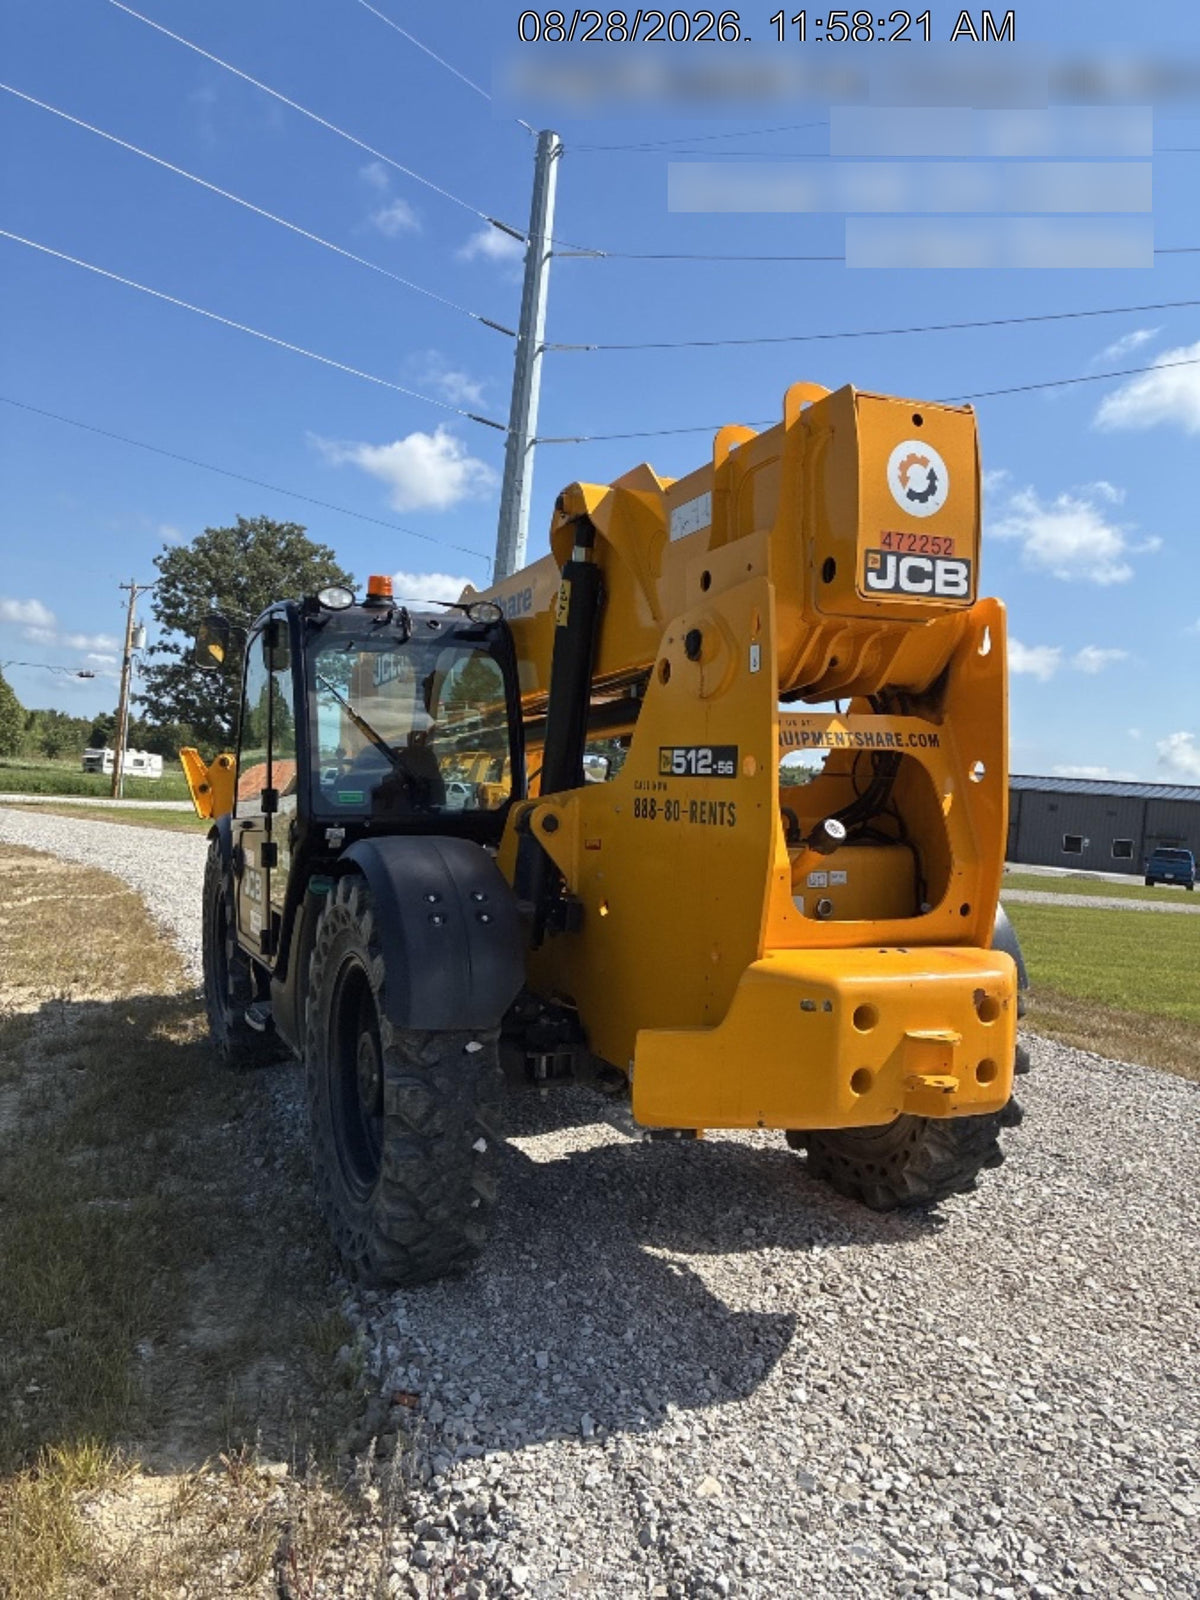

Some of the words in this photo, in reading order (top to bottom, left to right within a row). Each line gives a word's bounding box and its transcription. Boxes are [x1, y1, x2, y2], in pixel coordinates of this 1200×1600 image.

[882, 531, 953, 555] 472252
[867, 554, 968, 596] JCB
[491, 587, 533, 620] hare
[634, 798, 737, 827] 888-80-RENTS
